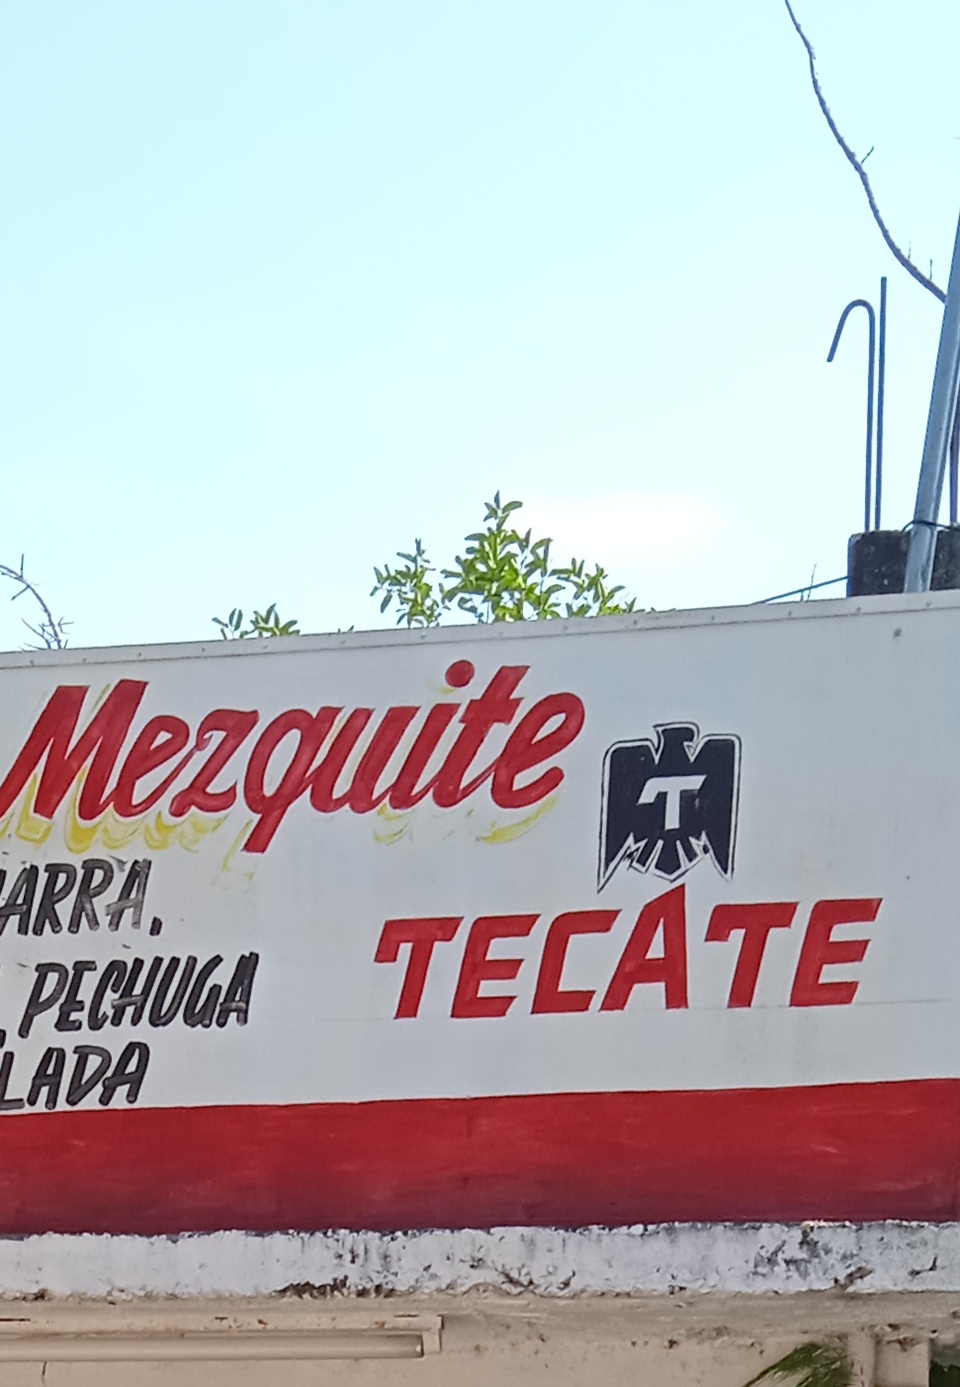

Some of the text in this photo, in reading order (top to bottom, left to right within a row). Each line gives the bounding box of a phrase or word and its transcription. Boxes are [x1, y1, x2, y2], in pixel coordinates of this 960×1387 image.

[637, 774, 707, 831] T
[18, 951, 260, 1039] PECHUGA
[373, 883, 884, 1020] TECATE
